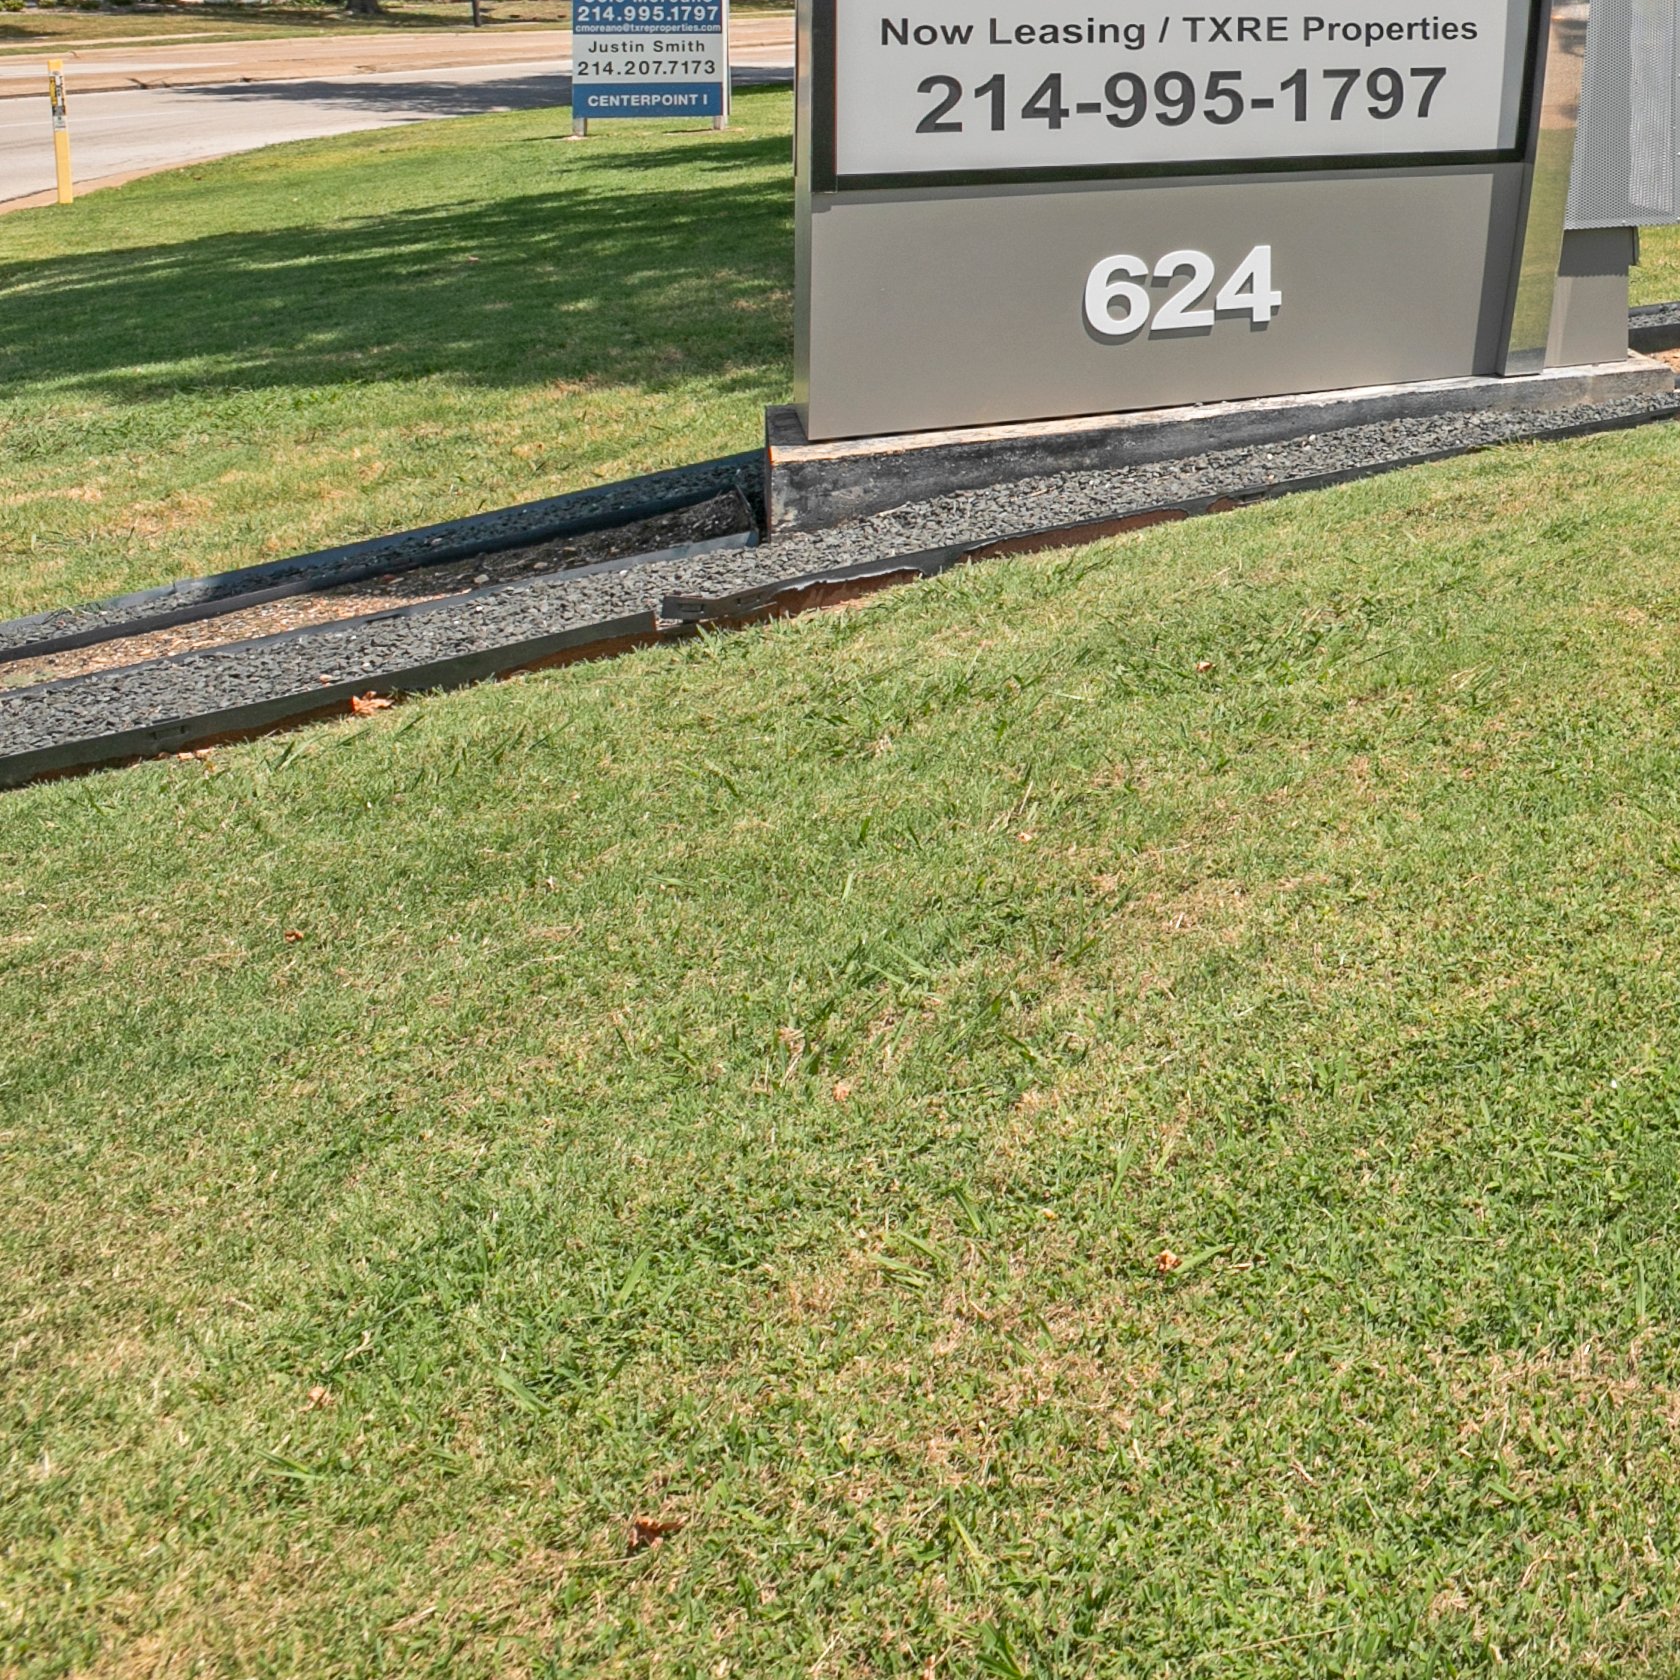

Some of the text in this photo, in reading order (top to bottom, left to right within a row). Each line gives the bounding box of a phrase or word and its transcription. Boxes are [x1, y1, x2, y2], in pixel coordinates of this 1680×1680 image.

[578, 6, 719, 21] 214.995.1797
[575, 23, 721, 34] cmoreano@txreproperties.com
[880, 15, 1479, 50] Now Leasing / TXRE Properties
[588, 40, 705, 54] Justin Smith
[578, 60, 716, 76] 214.207.7173
[588, 94, 697, 107] CENTERPOINT
[914, 67, 1448, 134] 214-995-1797
[1083, 244, 1283, 336] 624
